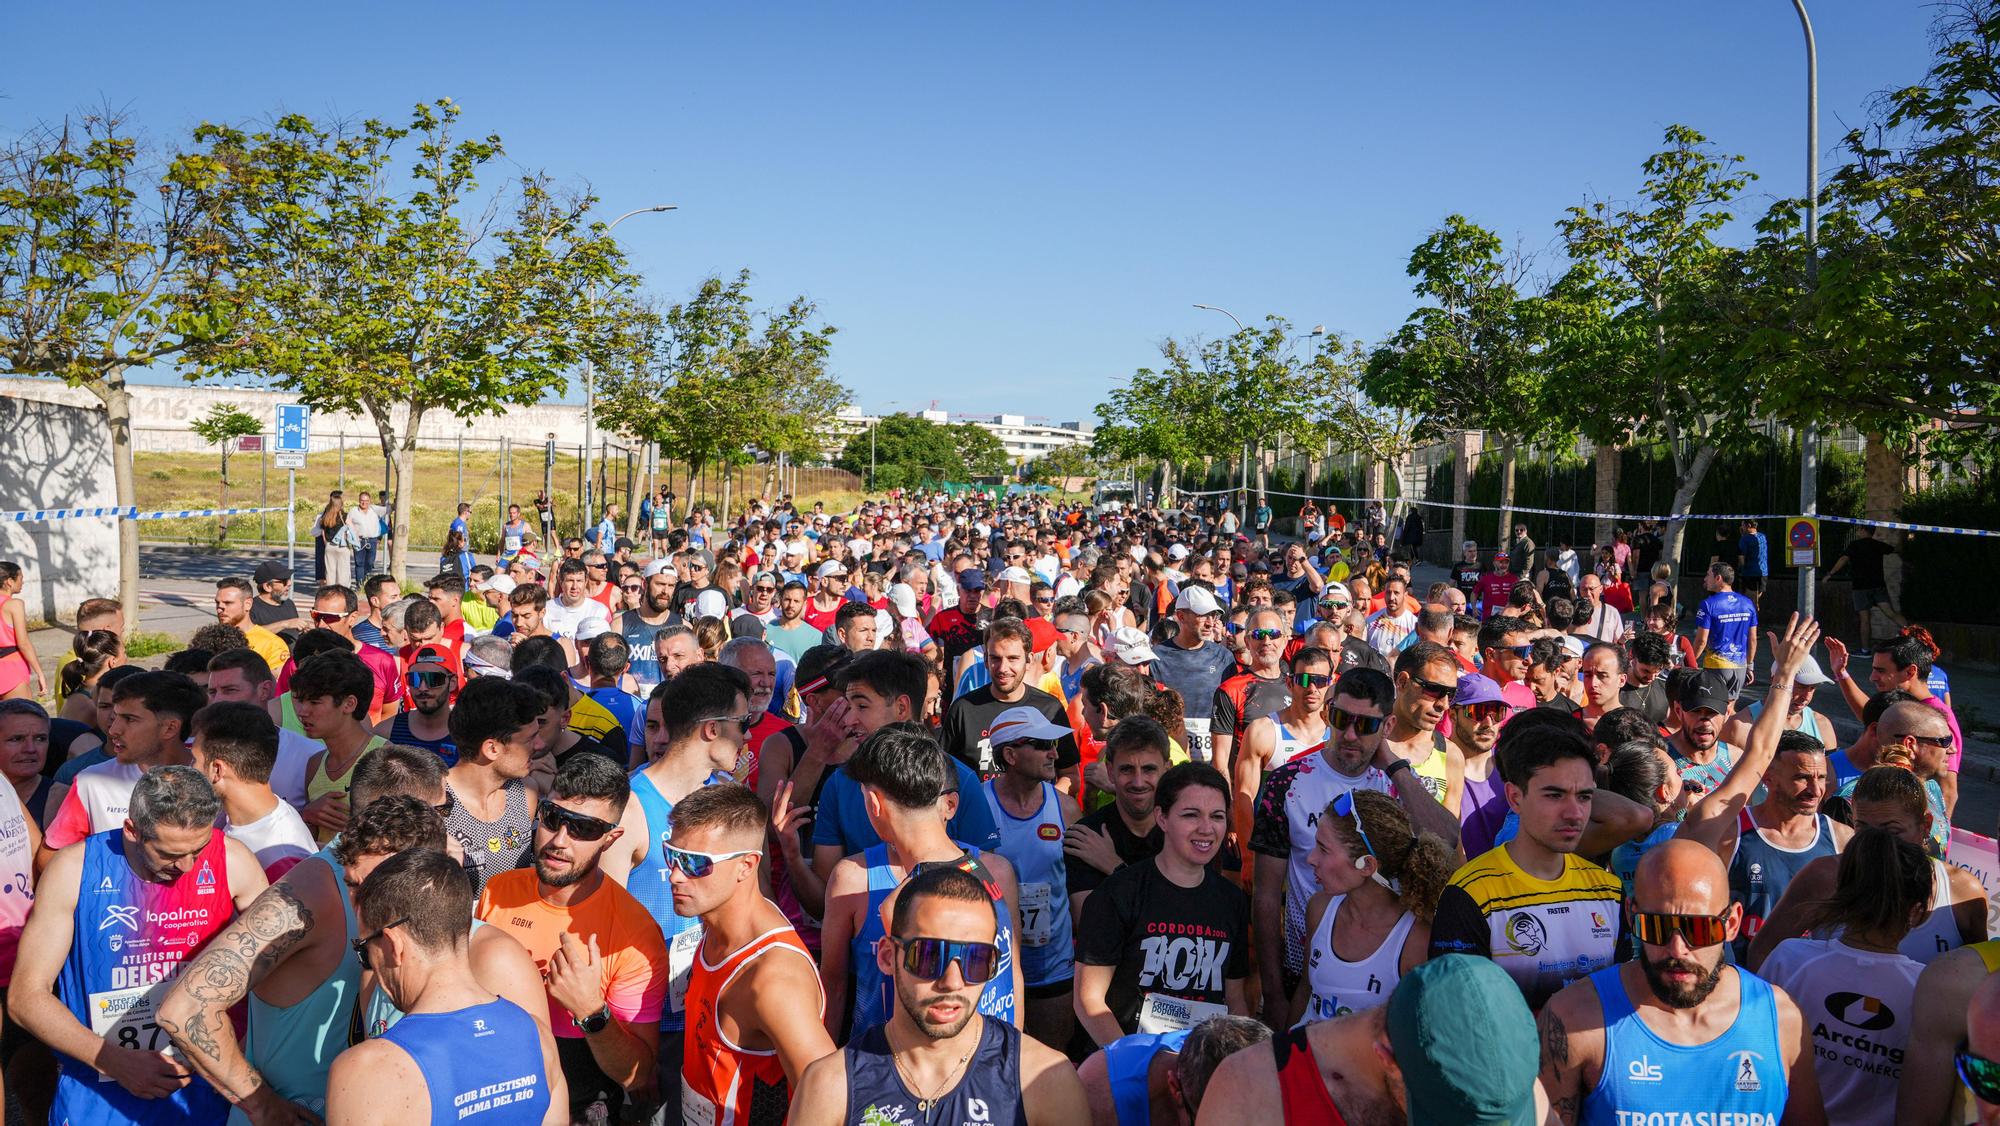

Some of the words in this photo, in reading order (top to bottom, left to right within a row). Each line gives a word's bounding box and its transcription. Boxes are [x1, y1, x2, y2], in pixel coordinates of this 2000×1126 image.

[146, 907, 208, 927] lapalma
[1547, 906, 1570, 916] FASTER
[164, 919, 208, 930] cooperativa
[511, 916, 534, 929] GOBIK
[1147, 922, 1212, 936] CORDOBA
[122, 951, 183, 965] ATLETISMO
[1139, 935, 1231, 991] 10K
[106, 994, 142, 1006] arreras
[980, 986, 997, 1009] CLUB
[1151, 1005, 1191, 1020] populares
[1153, 1000, 1187, 1014] carreras
[118, 1022, 180, 1051] 87
[1628, 1054, 1664, 1081] als
[454, 1089, 478, 1107] CLUB
[479, 1074, 537, 1099] ATLETISMO
[458, 1099, 491, 1121] PALMA
[492, 1093, 513, 1108] DEL
[514, 1088, 534, 1102] RÍO
